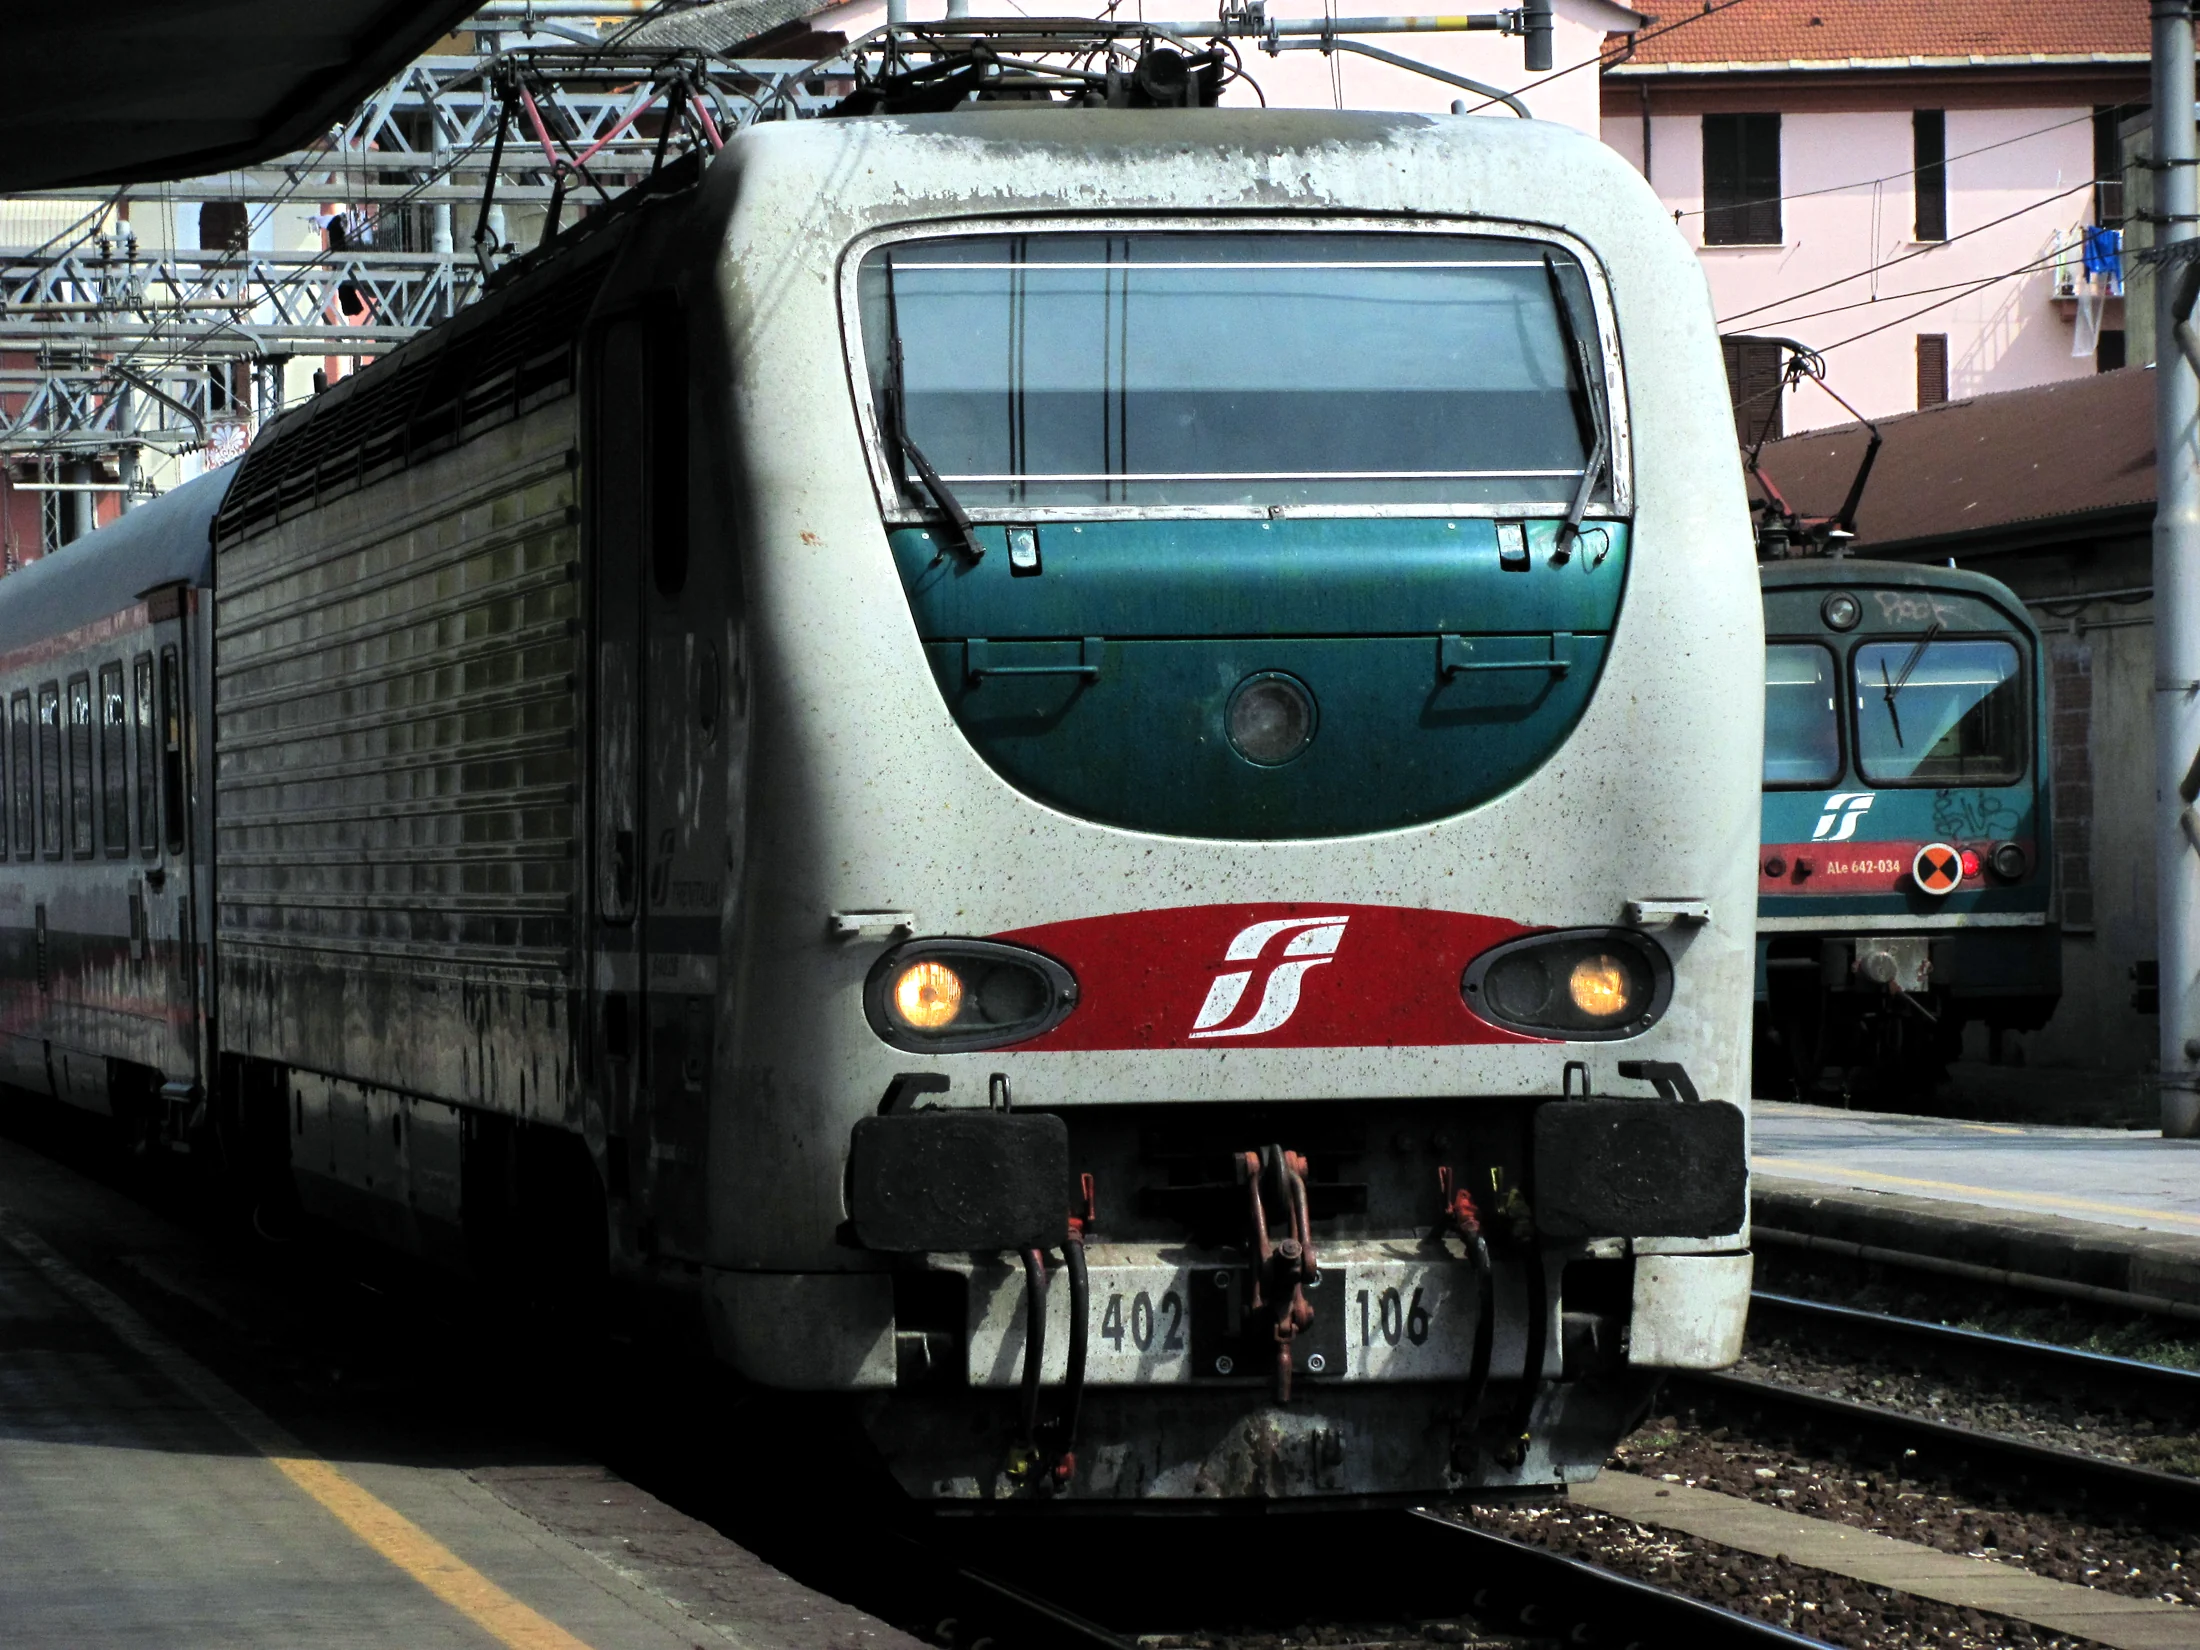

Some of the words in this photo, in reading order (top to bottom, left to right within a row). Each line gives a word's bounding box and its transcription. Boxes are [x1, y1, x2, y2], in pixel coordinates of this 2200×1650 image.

[1851, 859, 1901, 874] 642-034
[1101, 1290, 1184, 1353] 402
[1355, 1287, 1431, 1348] 106
